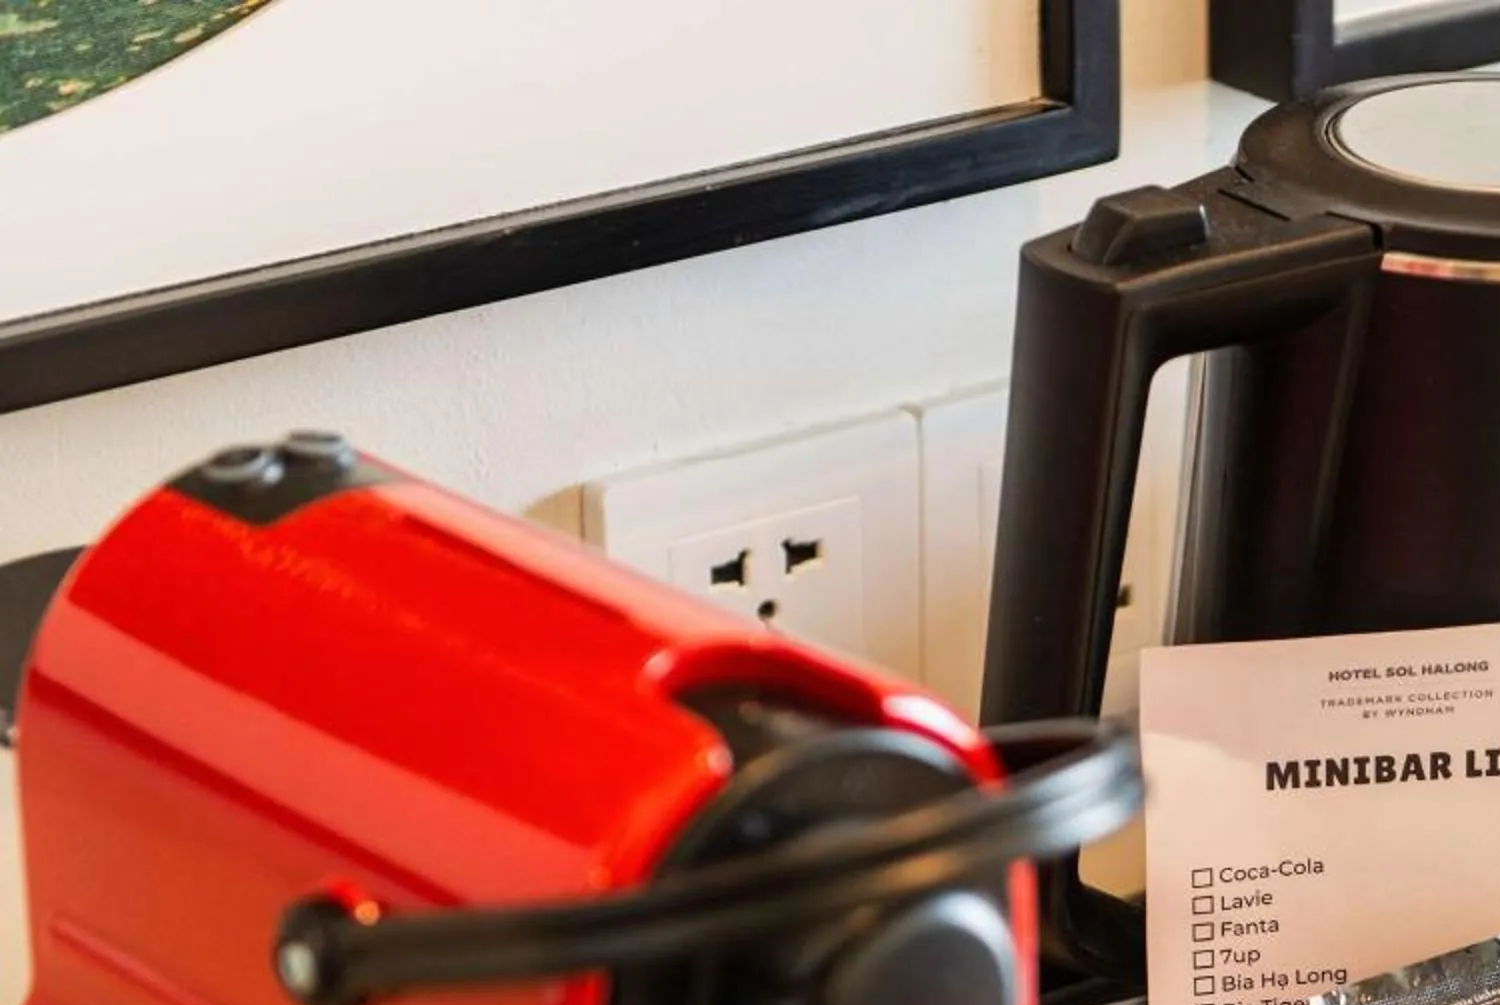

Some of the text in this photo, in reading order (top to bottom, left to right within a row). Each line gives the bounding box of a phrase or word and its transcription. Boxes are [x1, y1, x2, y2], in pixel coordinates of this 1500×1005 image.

[1328, 660, 1490, 682] HOTEL SOL HALONG
[1320, 689, 1494, 709] TRADEMARK COLLECTION
[1385, 705, 1455, 718] WYNDHAM
[1265, 753, 1451, 791] MINIBAR
[1219, 858, 1325, 883] Coca-Cola
[1221, 890, 1273, 911] Lavie
[1221, 919, 1279, 937] Fanta
[1220, 949, 1261, 966] 7up
[1222, 968, 1347, 992] Bia Hạ Long
